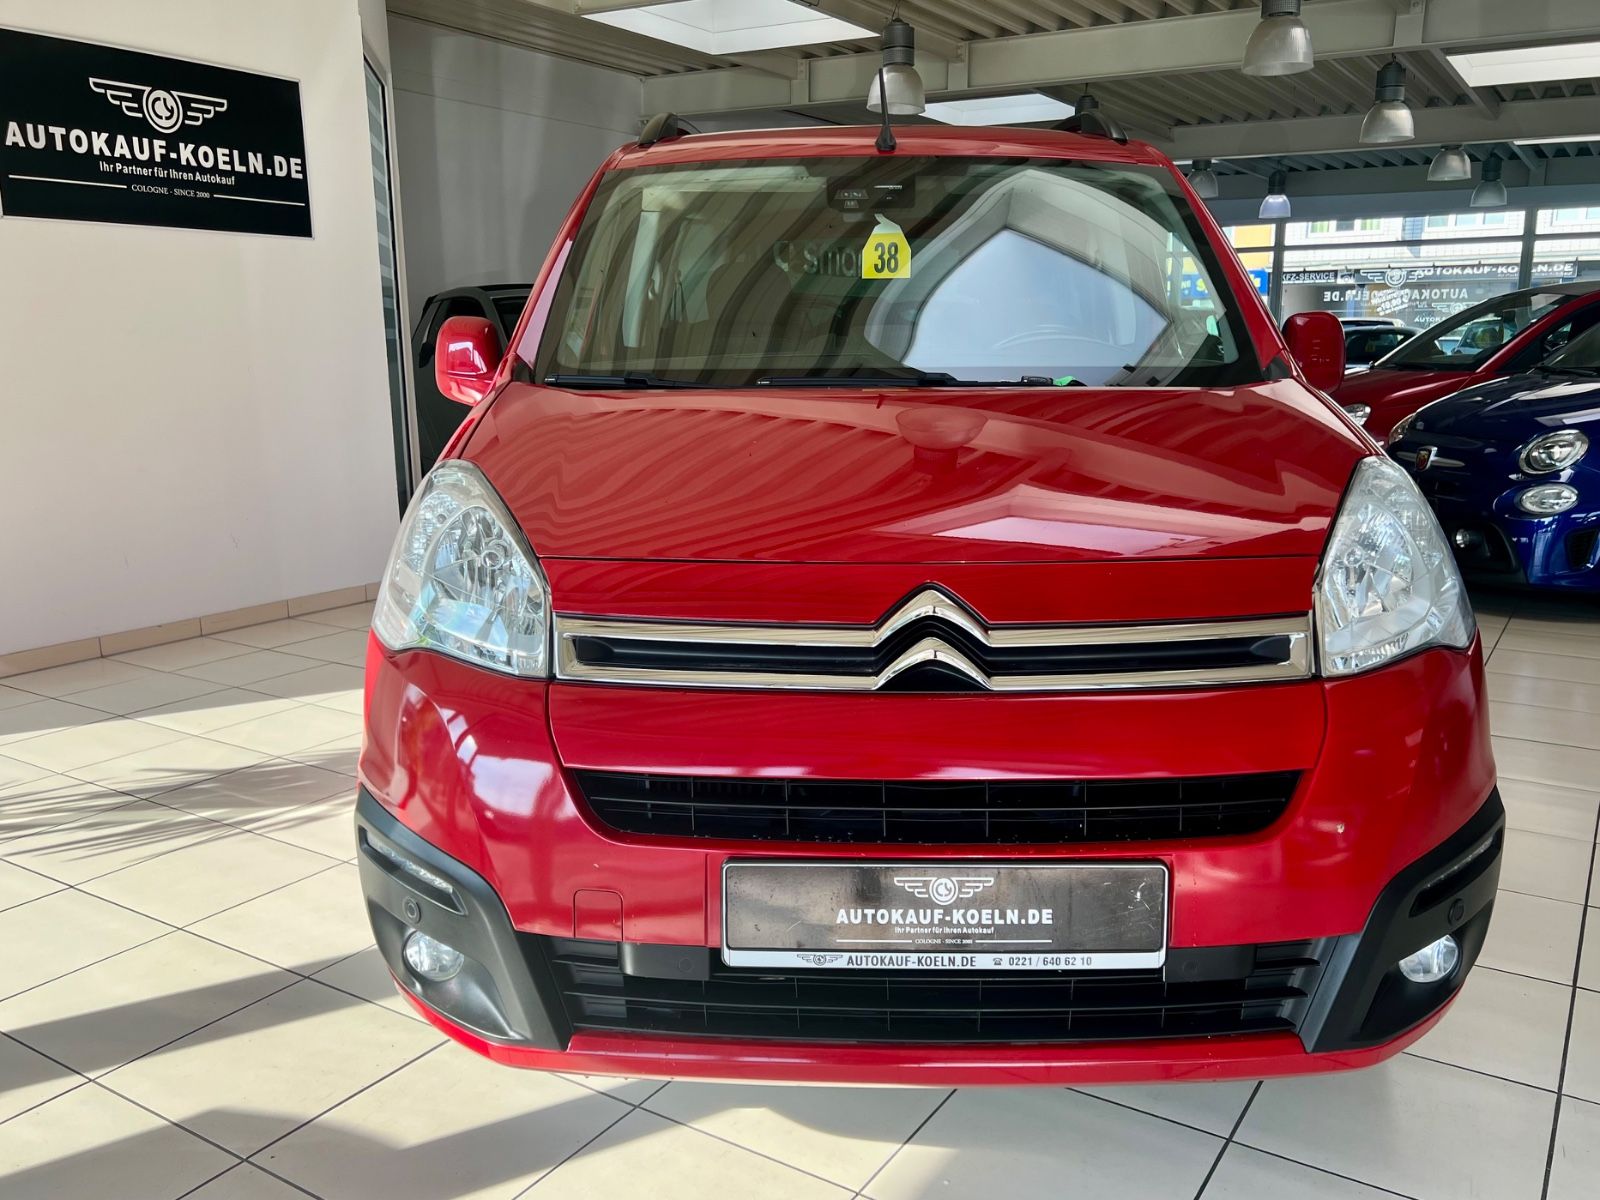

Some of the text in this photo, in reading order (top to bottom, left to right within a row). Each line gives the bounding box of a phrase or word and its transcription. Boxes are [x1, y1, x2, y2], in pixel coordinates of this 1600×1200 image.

[5, 121, 304, 180] AUTOKAUF-KOELN.DE
[99, 160, 235, 186] Ihr Partner für Ihren Autokauf
[131, 184, 169, 195] COLOGNE
[173, 188, 195, 197] SINCE
[196, 191, 210, 199] 2000
[873, 241, 899, 274] 38
[1416, 263, 1574, 277] UTOKAUF-KON.DE
[836, 908, 1053, 925] AUTOKAUF-KOELN.DE
[894, 926, 995, 935] Ihr Partner für Ihren Autokauf
[846, 955, 977, 968] AUTOKAUF-KOELN.DE
[1008, 955, 1033, 967] 0221
[1042, 955, 1062, 966] 640
[1064, 955, 1078, 966] 62
[1080, 955, 1093, 966] 10
